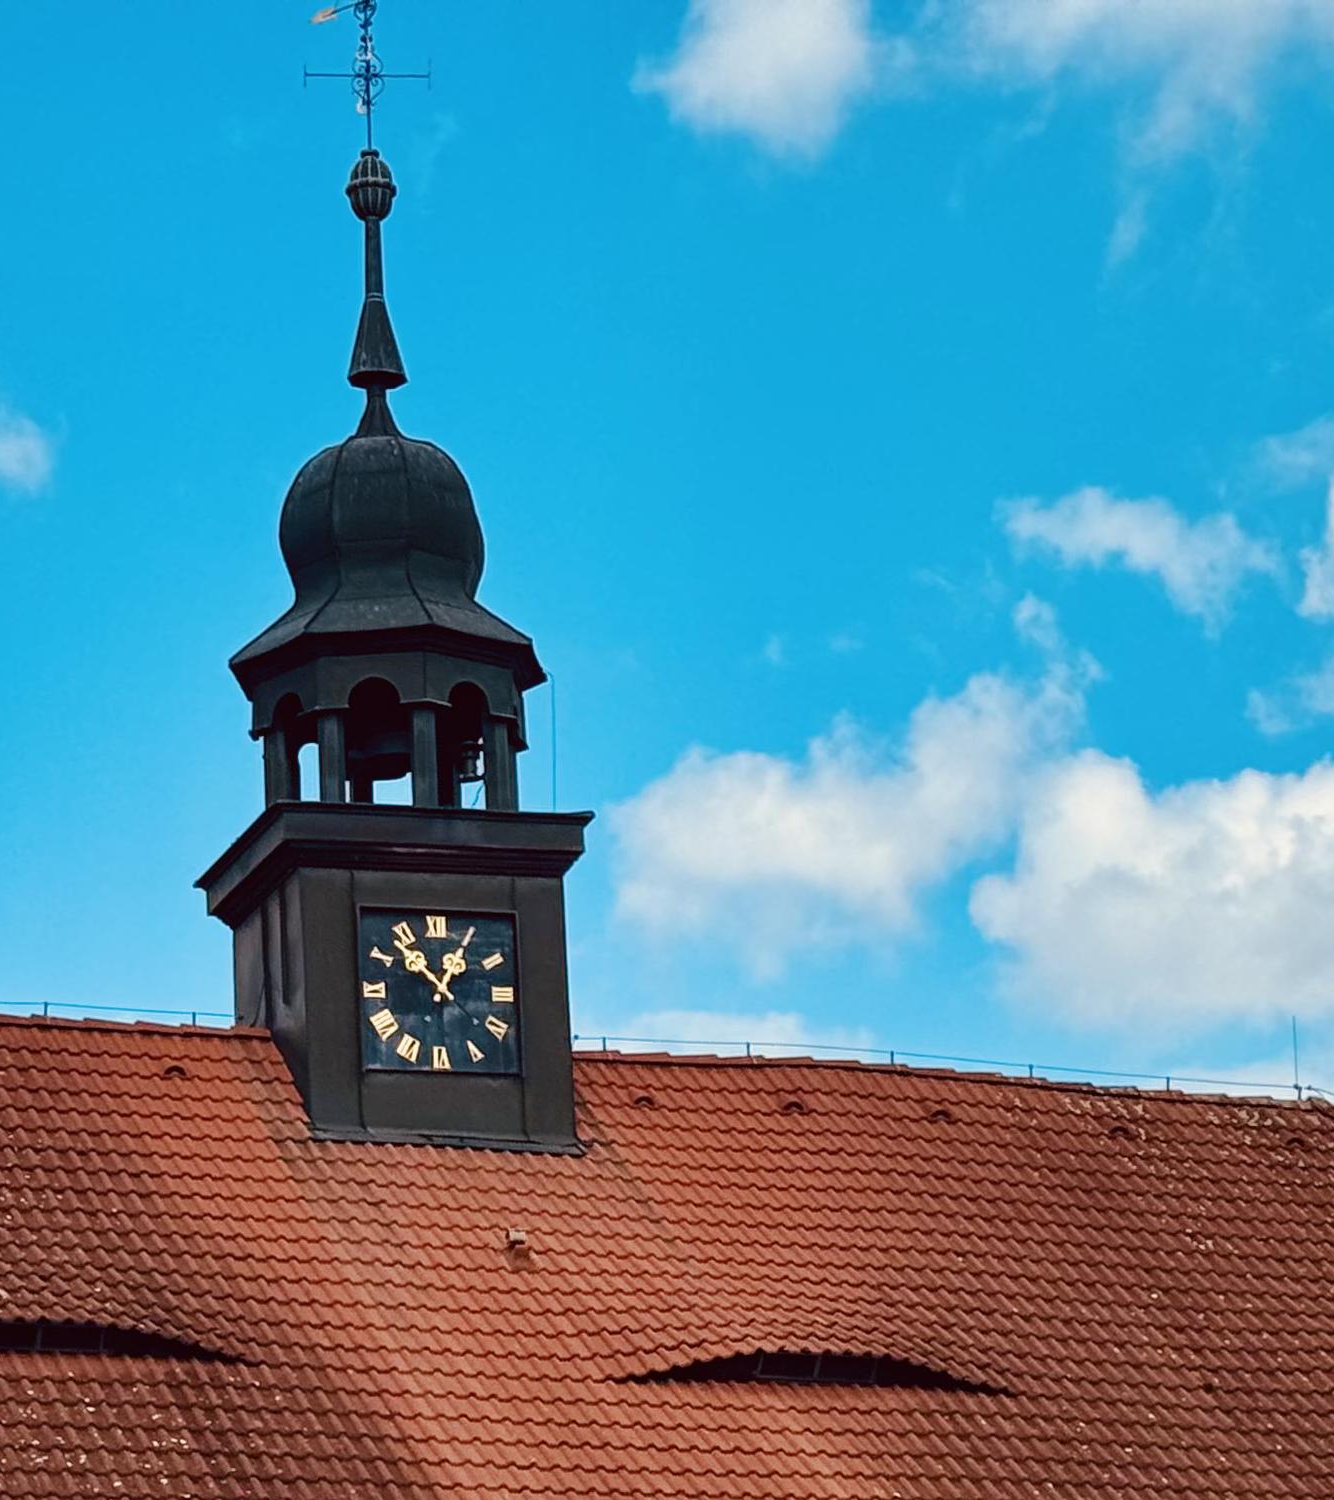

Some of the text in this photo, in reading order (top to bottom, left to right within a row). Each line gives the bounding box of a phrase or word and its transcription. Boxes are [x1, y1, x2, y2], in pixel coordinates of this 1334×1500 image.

[424, 915, 447, 938] XII
[369, 945, 395, 968] X
[481, 952, 505, 971] II
[362, 981, 386, 999] IX
[491, 986, 514, 1003] III
[396, 1033, 421, 1064] VII
[432, 1046, 452, 1070] VI
